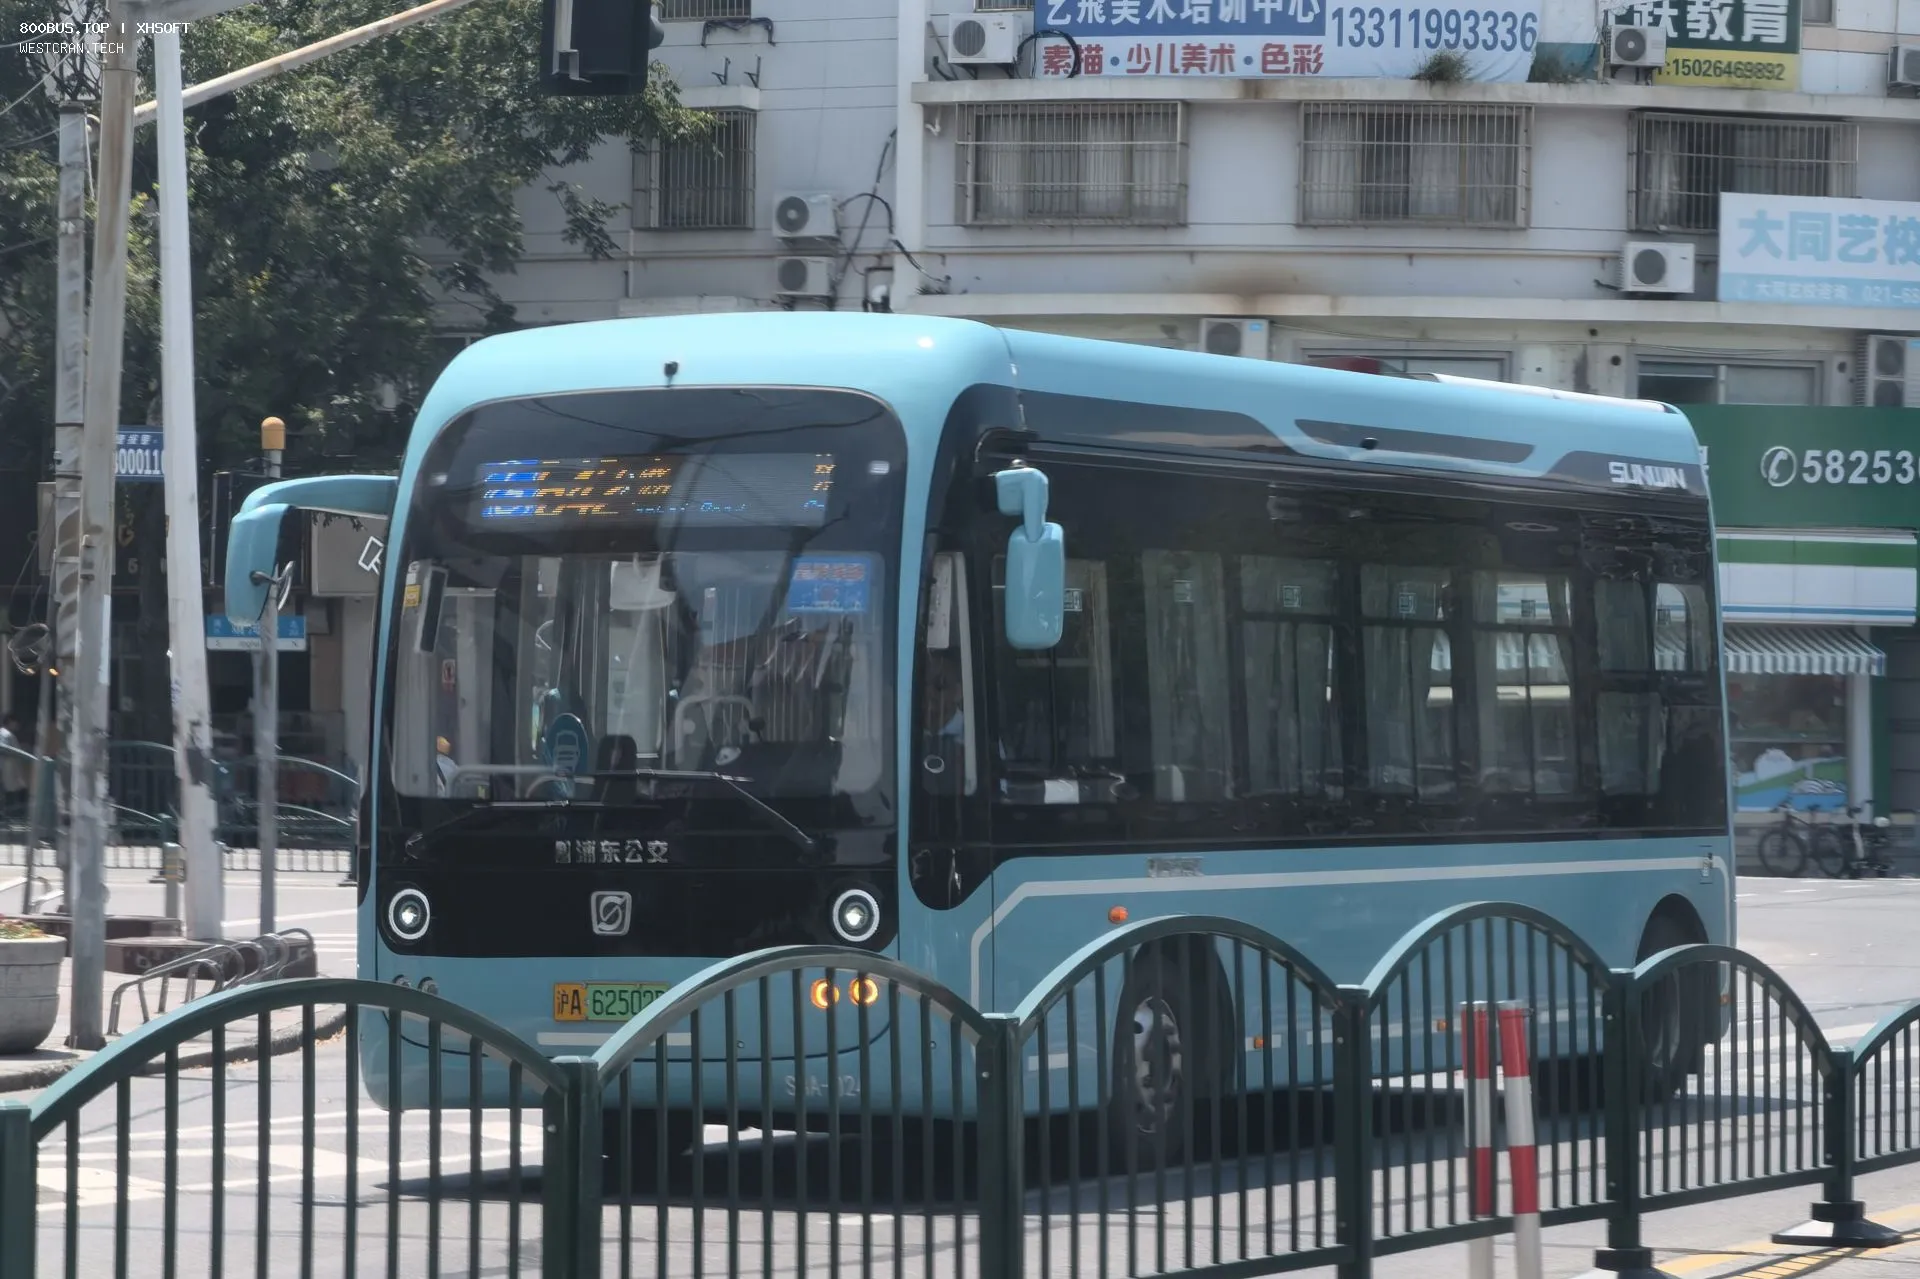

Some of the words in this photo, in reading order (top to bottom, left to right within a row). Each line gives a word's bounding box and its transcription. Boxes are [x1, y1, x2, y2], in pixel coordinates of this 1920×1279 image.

[1336, 8, 1537, 52] 13311993336
[1608, 461, 1687, 490] SUNWIN
[1802, 449, 1920, 485] 58253
[575, 838, 670, 864] 浦东公交
